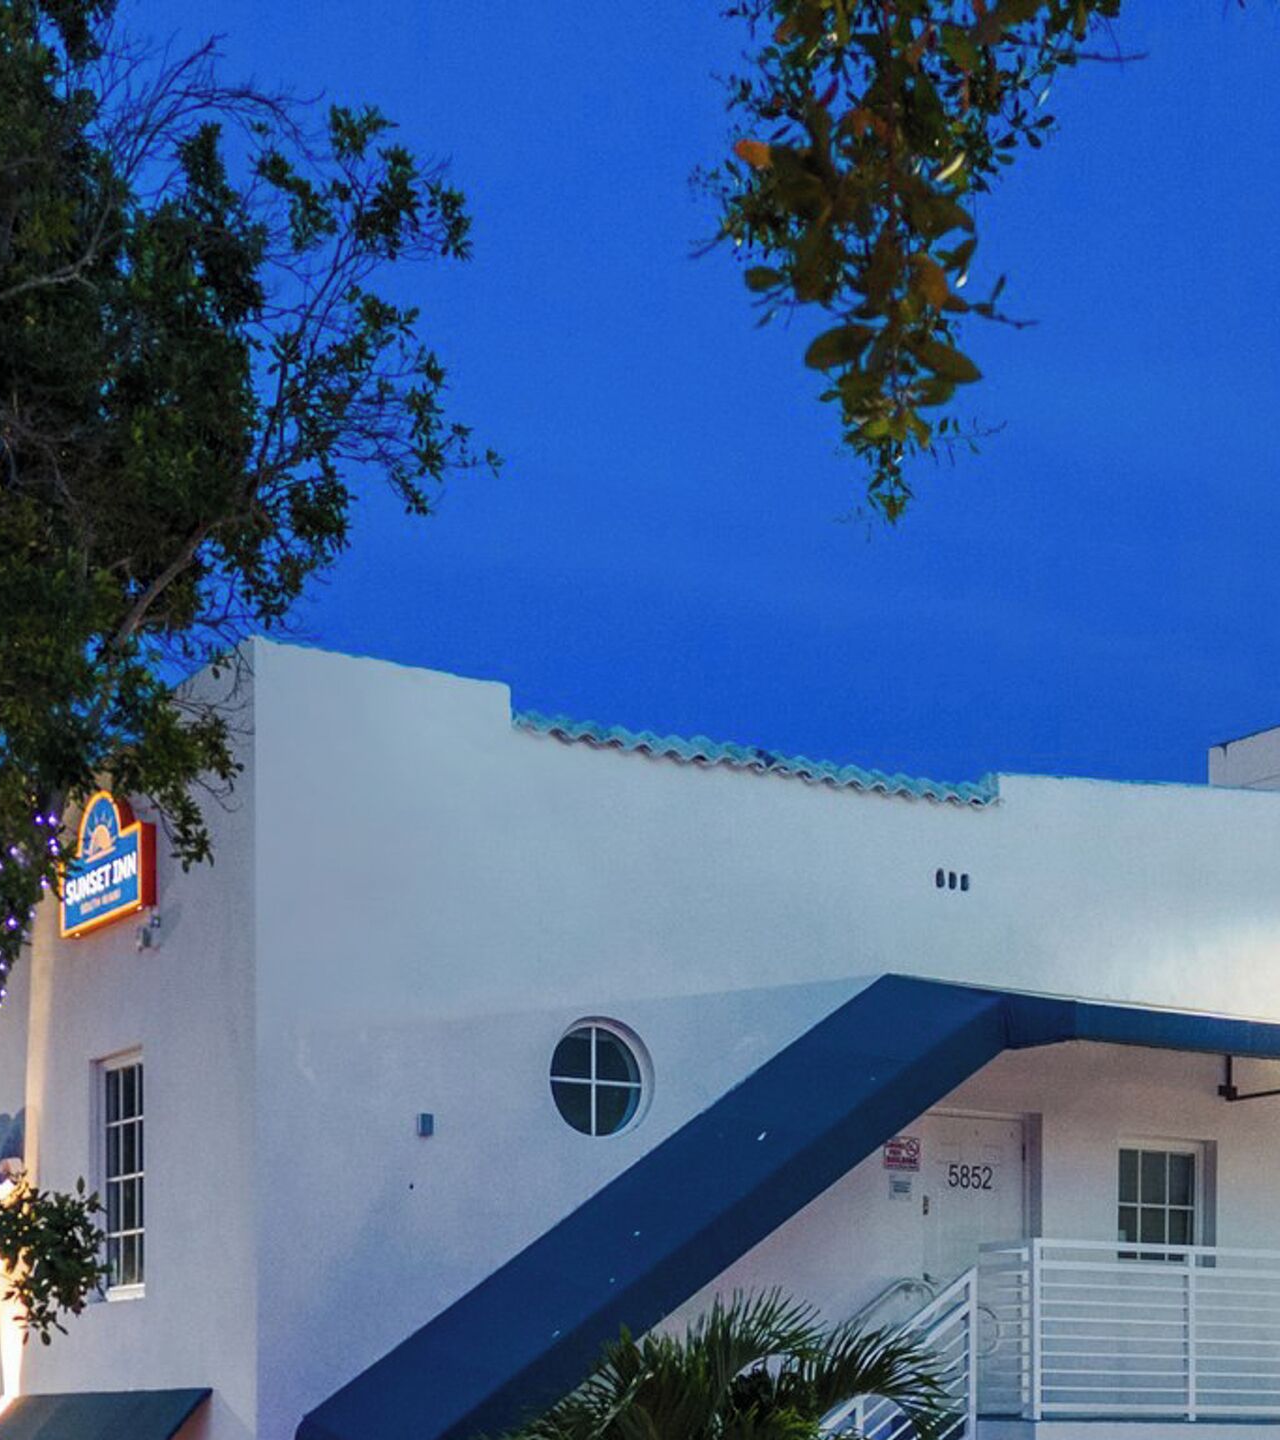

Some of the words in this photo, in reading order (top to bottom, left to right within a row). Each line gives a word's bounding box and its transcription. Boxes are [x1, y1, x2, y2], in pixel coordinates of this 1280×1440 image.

[66, 862, 112, 906] SUNSET
[112, 851, 137, 884] INN
[948, 1164, 993, 1190] 5852
